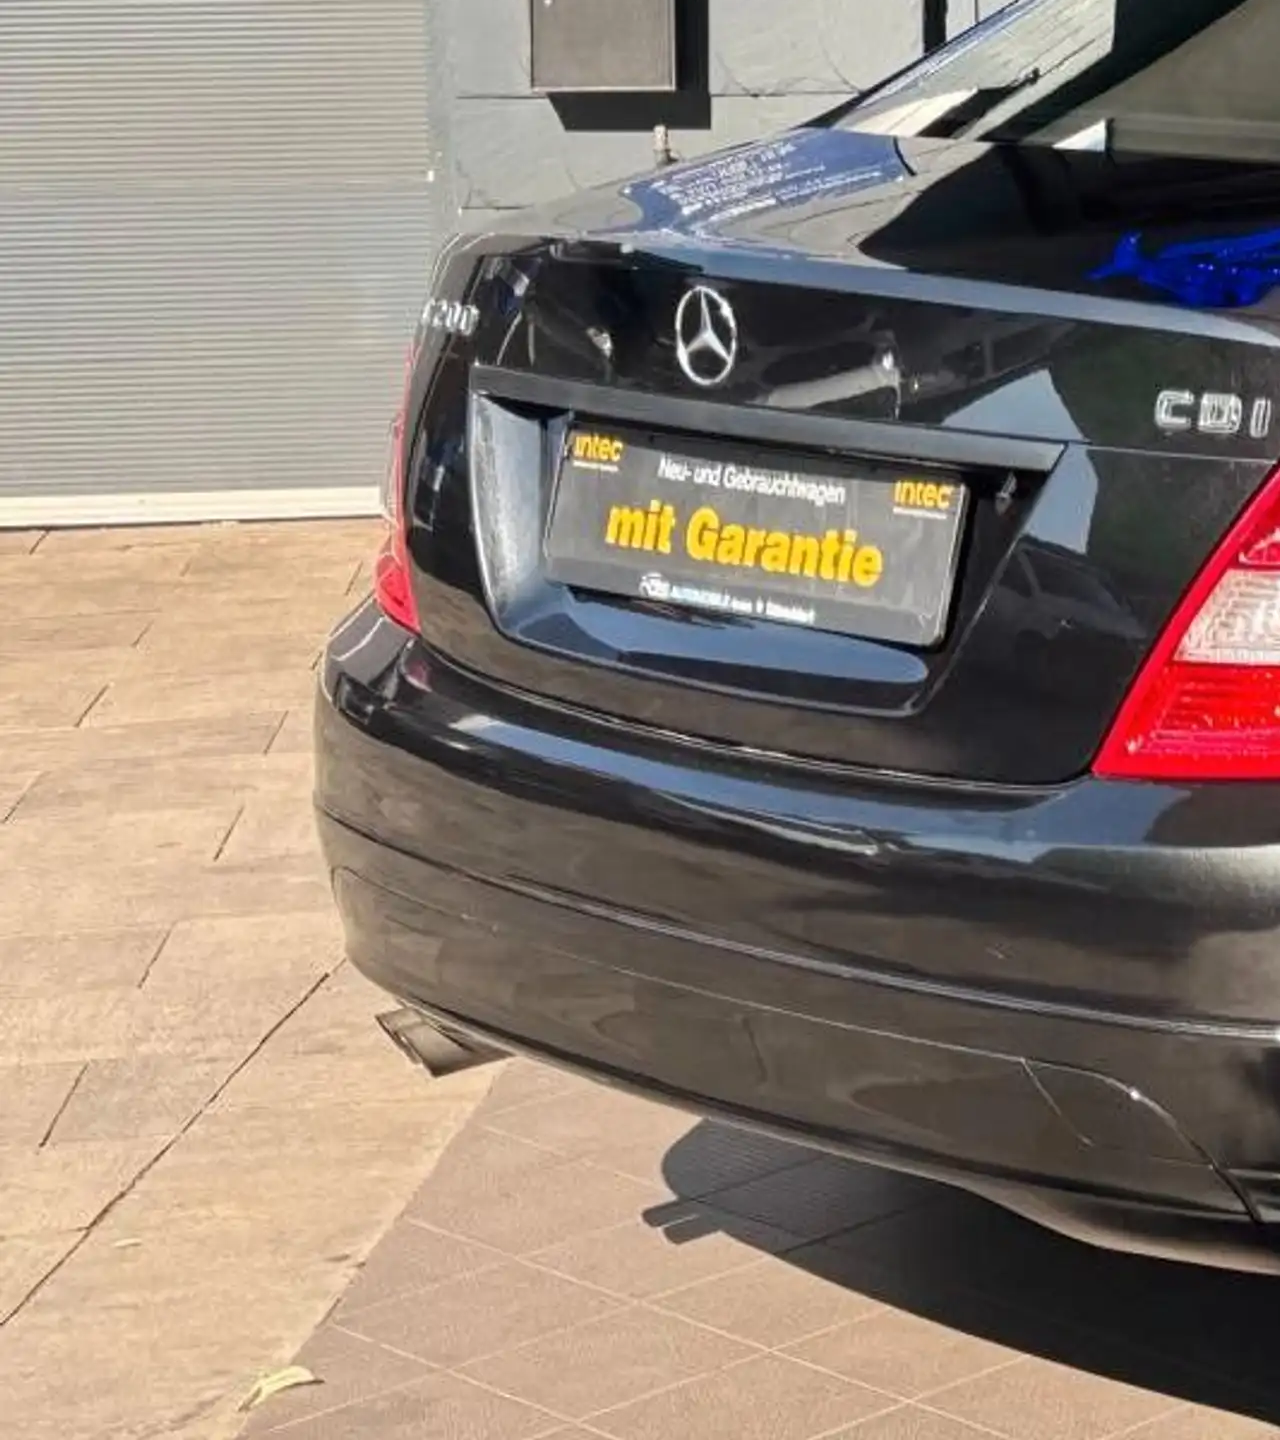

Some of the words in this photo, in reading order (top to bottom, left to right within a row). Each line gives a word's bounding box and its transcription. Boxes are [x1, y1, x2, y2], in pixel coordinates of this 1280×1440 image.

[1154, 389, 1272, 439] CDI
[658, 455, 692, 481] Neu-
[694, 459, 722, 486] und
[723, 463, 846, 507] Gebrauchtwagen
[604, 498, 677, 555] mit
[685, 504, 884, 588] Garantie
